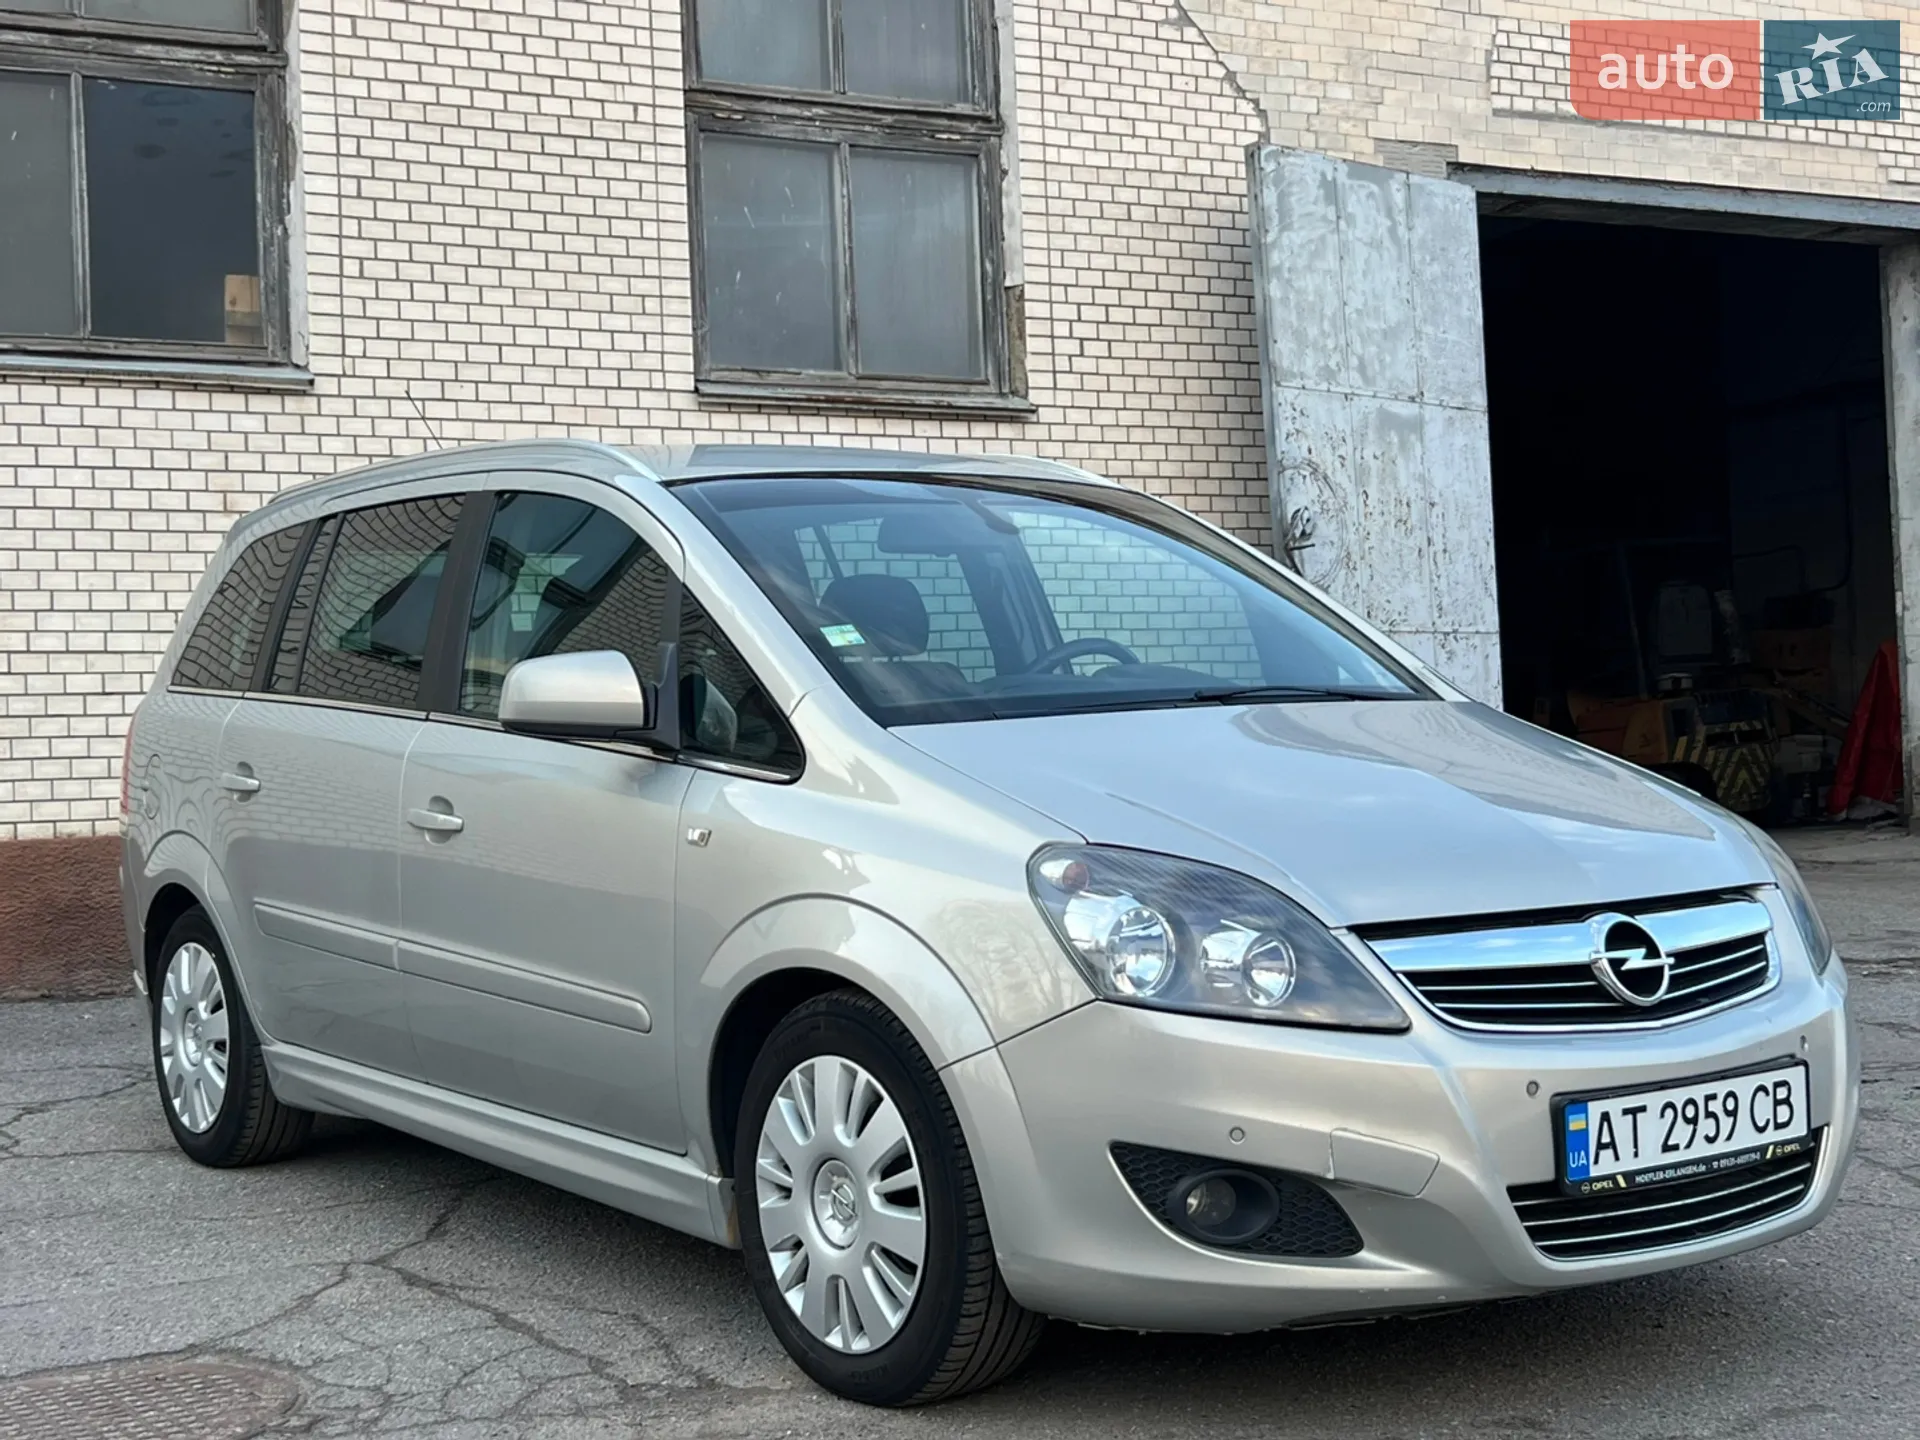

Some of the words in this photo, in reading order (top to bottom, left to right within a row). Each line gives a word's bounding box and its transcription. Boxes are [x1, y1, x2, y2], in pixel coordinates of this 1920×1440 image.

[1593, 1105, 1647, 1166] AT
[1659, 1090, 1739, 1153] 2959
[1750, 1080, 1794, 1134] CB
[1569, 1150, 1588, 1169] UA
[1592, 1181, 1613, 1191] OPEL
